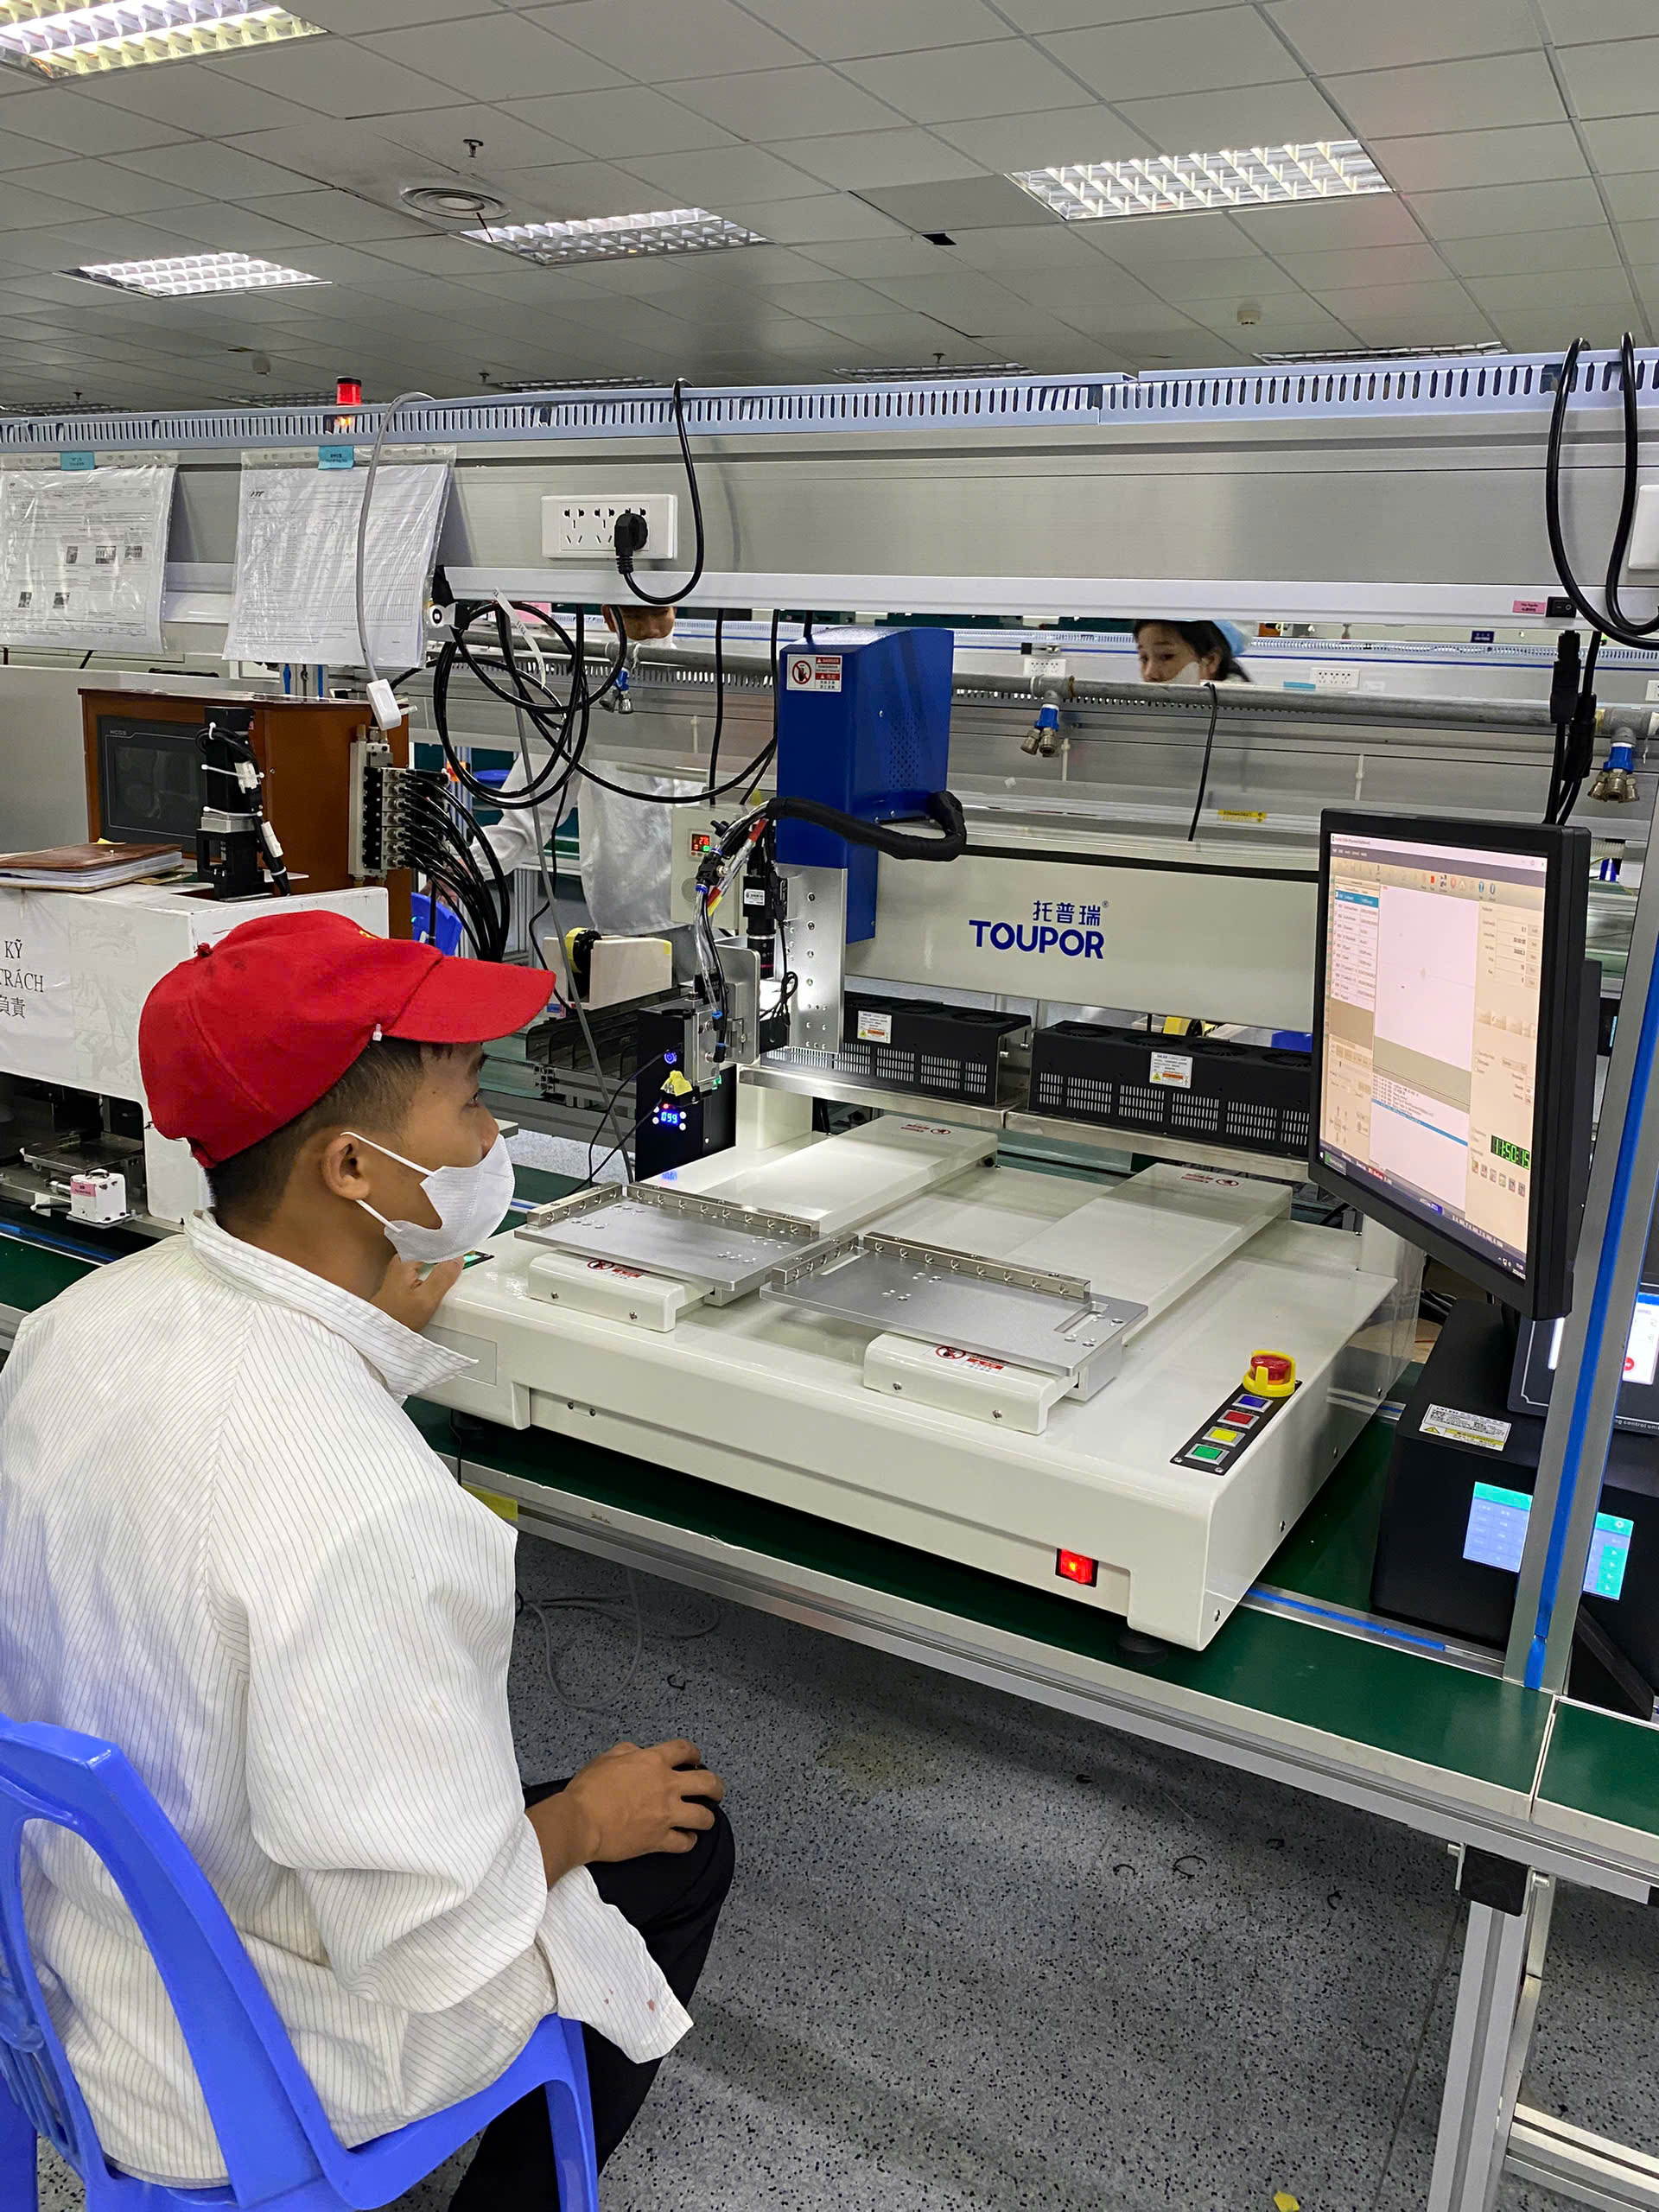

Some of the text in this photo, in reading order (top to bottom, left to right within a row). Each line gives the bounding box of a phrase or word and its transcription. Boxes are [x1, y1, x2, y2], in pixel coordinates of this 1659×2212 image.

[1033, 900, 1101, 926] 托普瑞
[4, 938, 22, 959] KỸ
[969, 919, 1104, 959] TOUPOR
